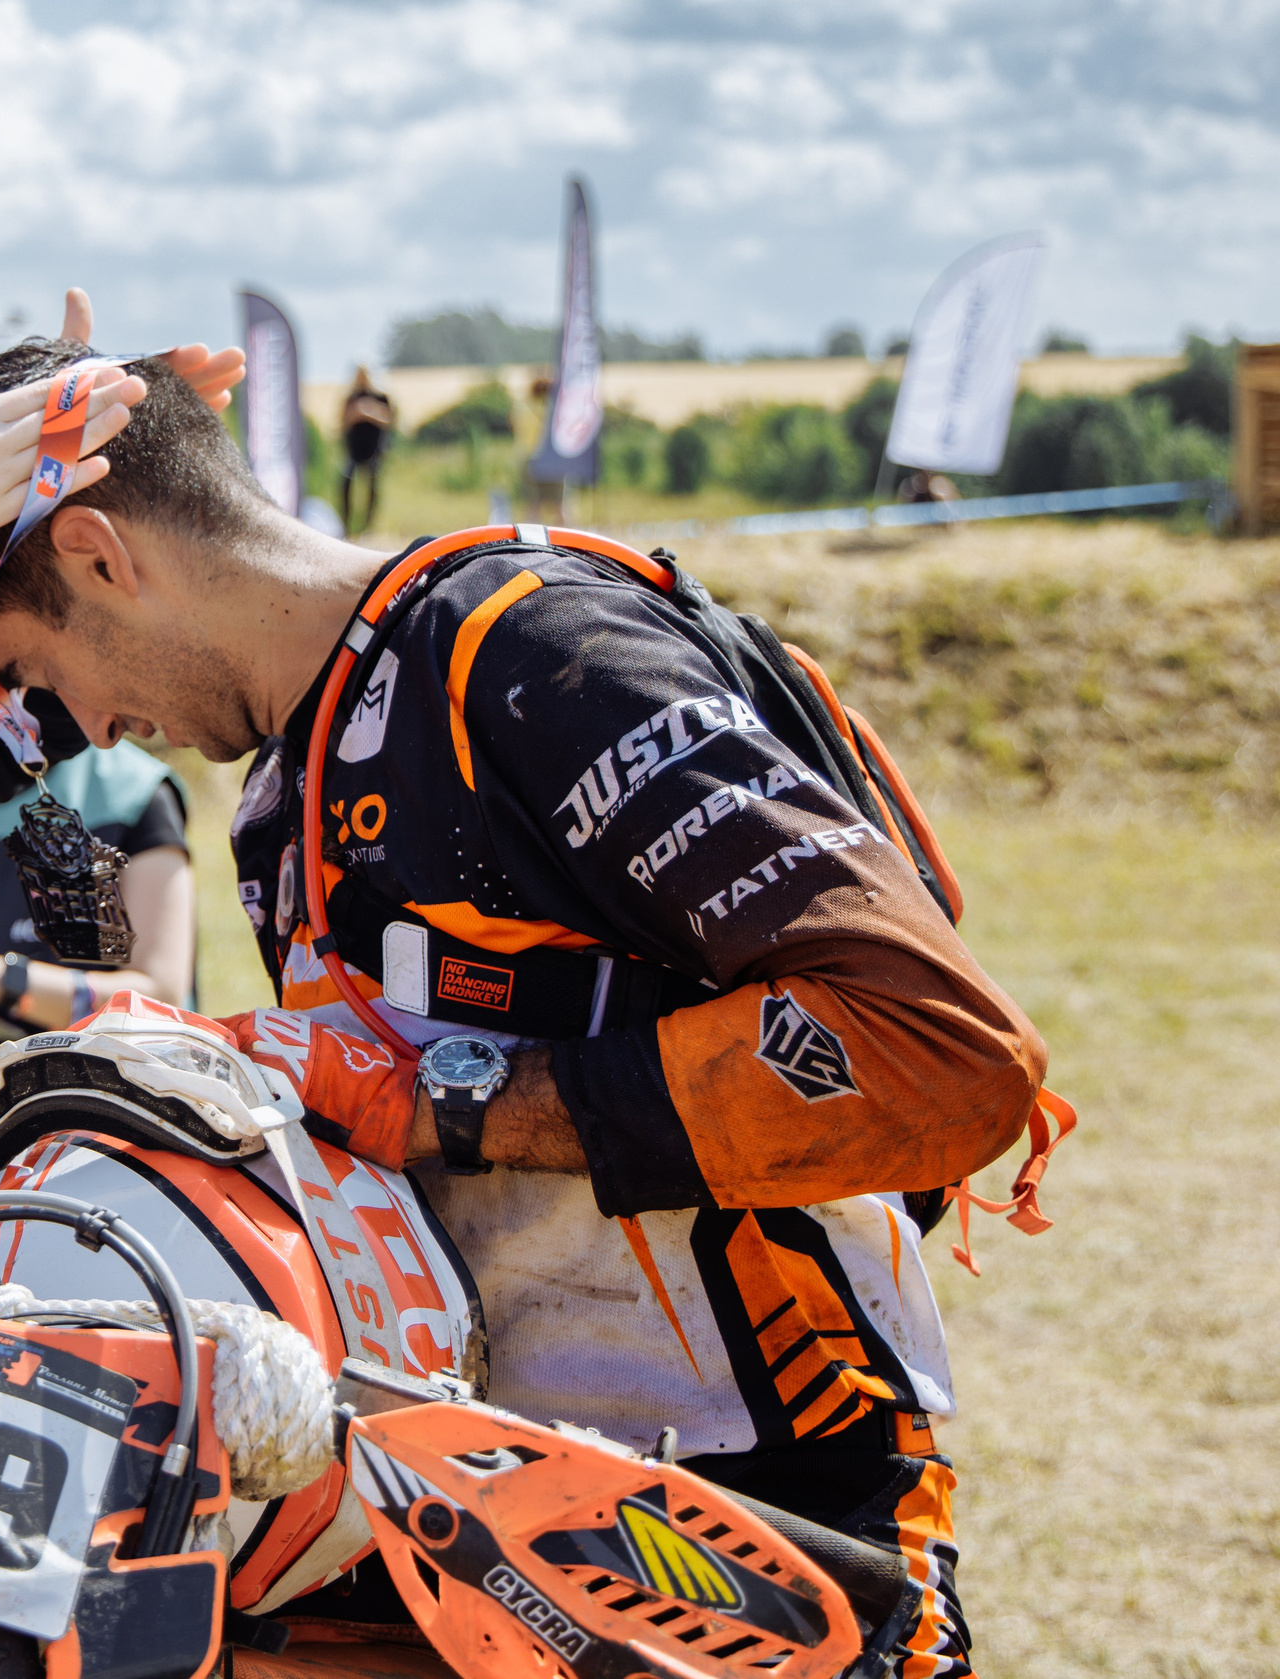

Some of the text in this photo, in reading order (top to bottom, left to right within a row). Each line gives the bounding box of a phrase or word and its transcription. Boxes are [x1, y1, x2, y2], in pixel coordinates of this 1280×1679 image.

[445, 962, 467, 976] NO
[442, 983, 503, 1004] MONKEY
[444, 973, 507, 994] DANCING
[482, 1564, 594, 1664] CYCRA
